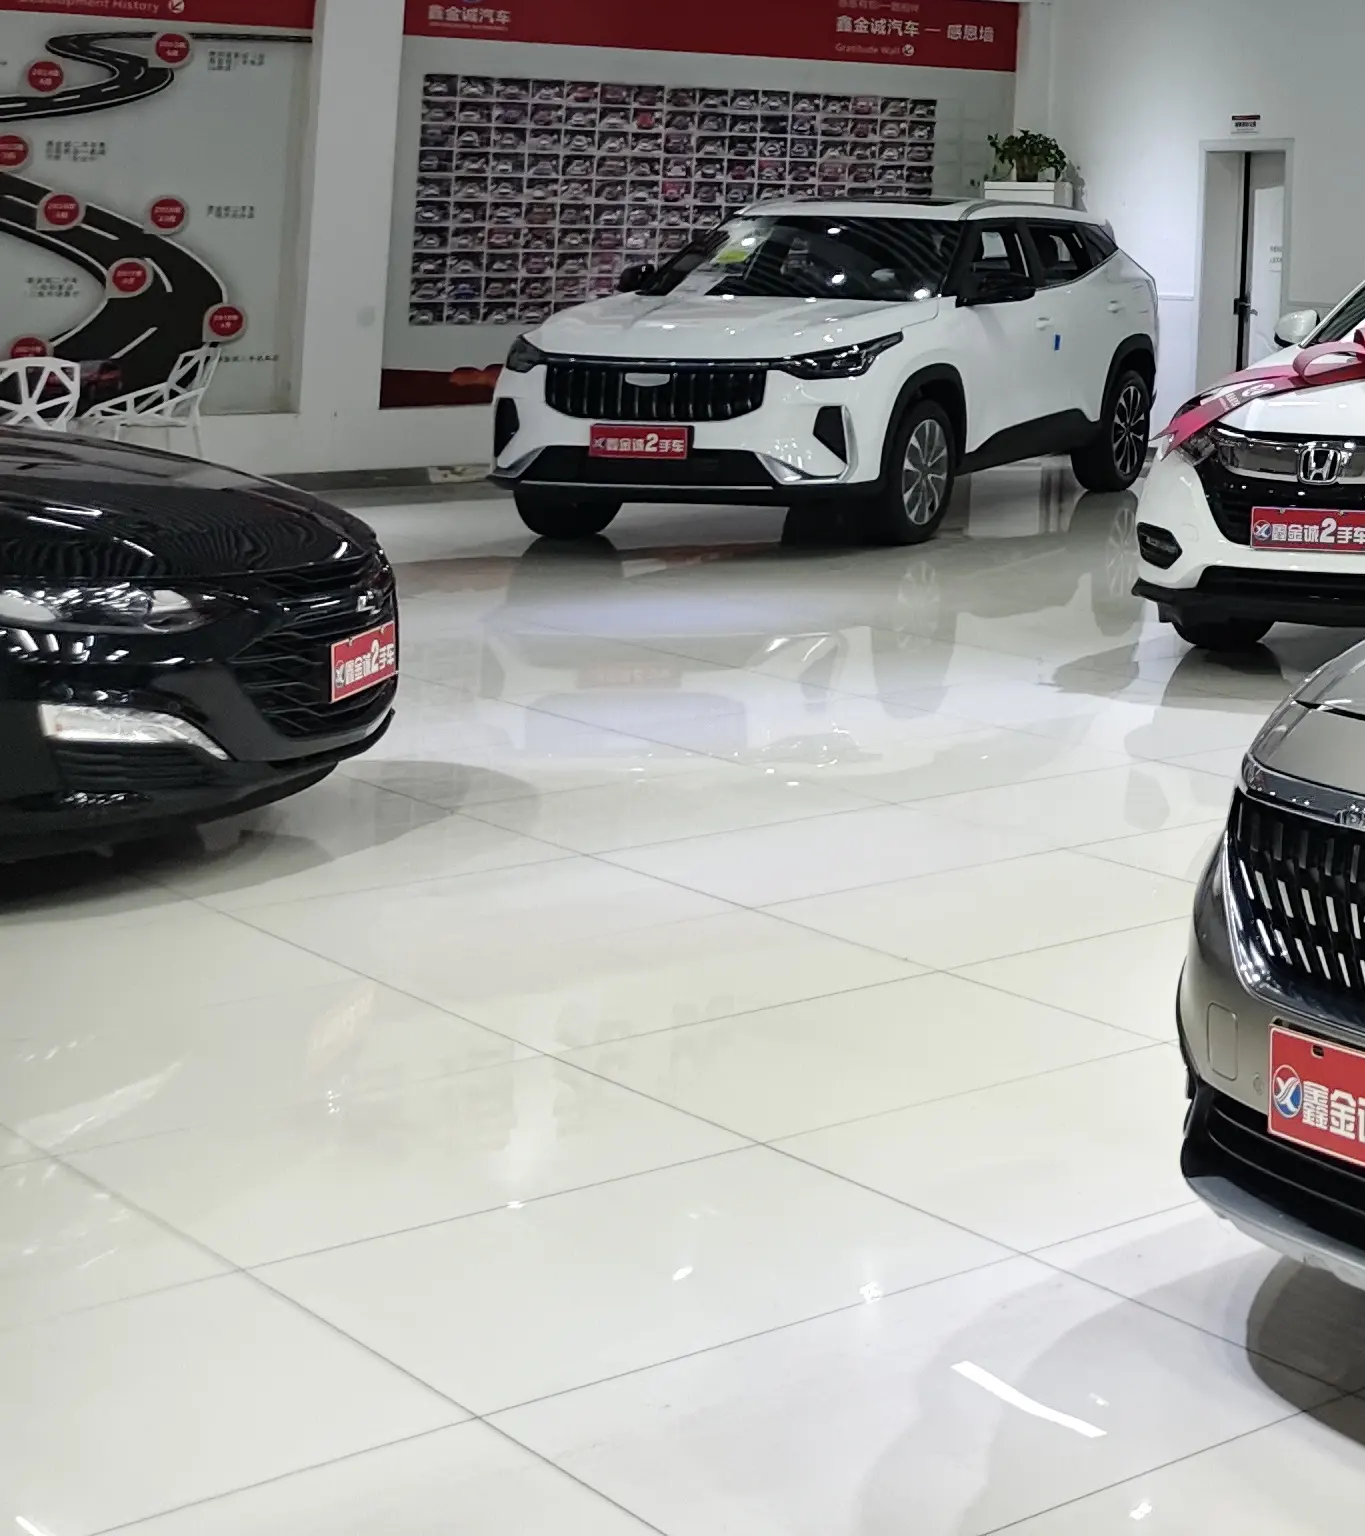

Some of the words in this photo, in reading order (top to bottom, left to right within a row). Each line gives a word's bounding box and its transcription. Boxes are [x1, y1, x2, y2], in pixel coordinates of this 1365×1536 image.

[836, 15, 920, 37] 鑫金诚汽车
[946, 24, 995, 43] 感恩墙
